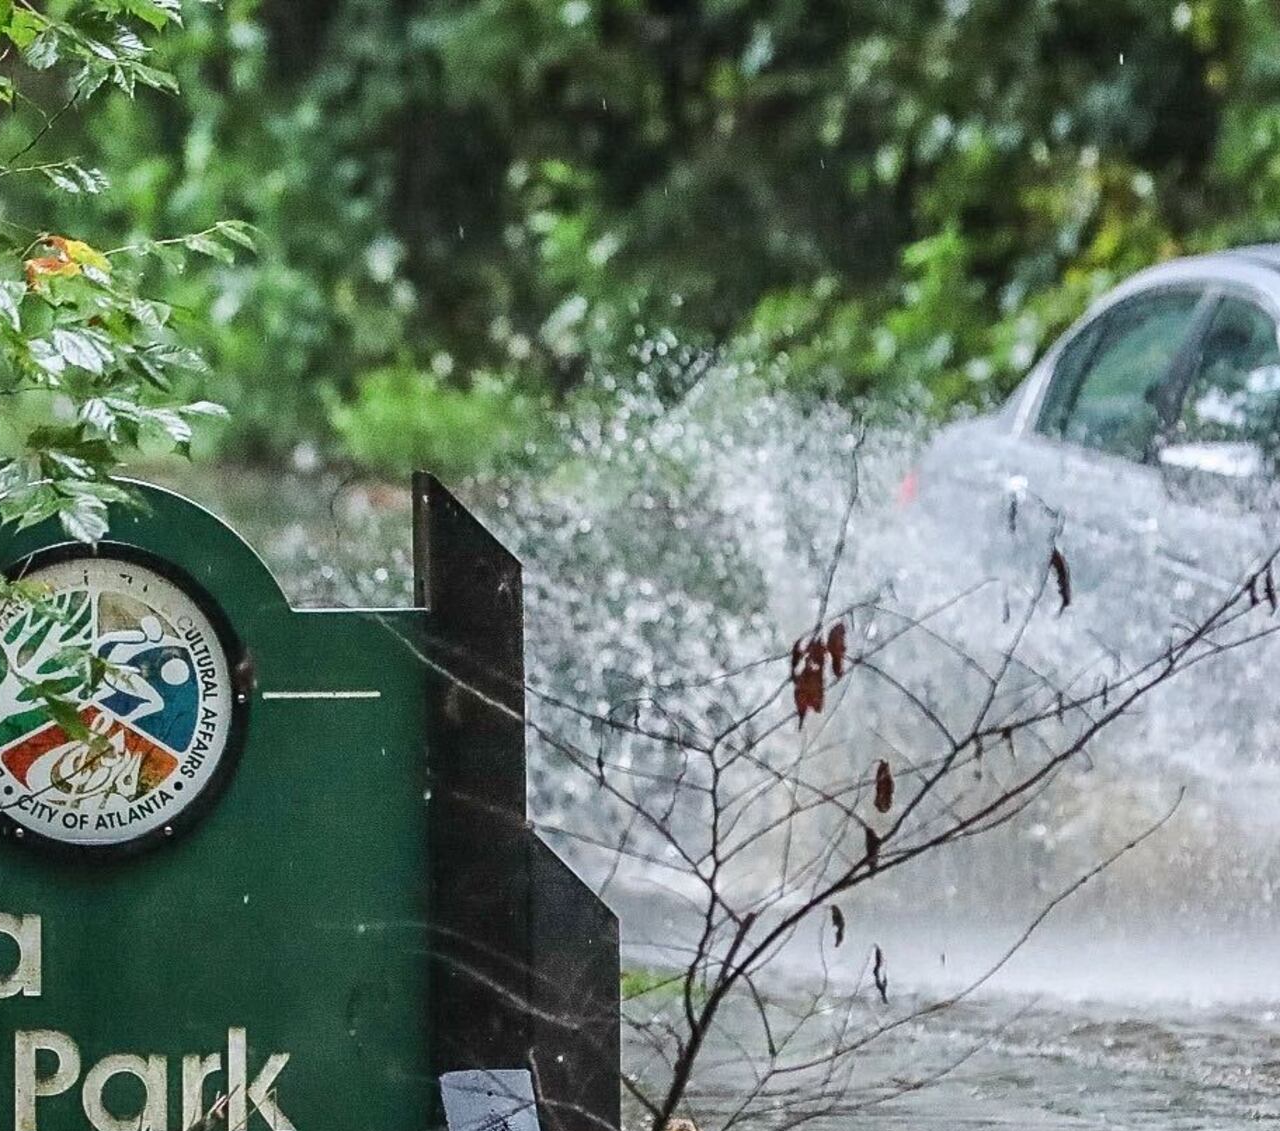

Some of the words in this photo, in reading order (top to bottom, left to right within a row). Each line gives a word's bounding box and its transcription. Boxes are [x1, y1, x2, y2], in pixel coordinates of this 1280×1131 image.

[176, 615, 218, 702] CULTURAL
[180, 707, 218, 779] AFFAIRS
[17, 793, 59, 824] CITY
[62, 812, 89, 830] OF
[95, 789, 174, 831] ATLANTA
